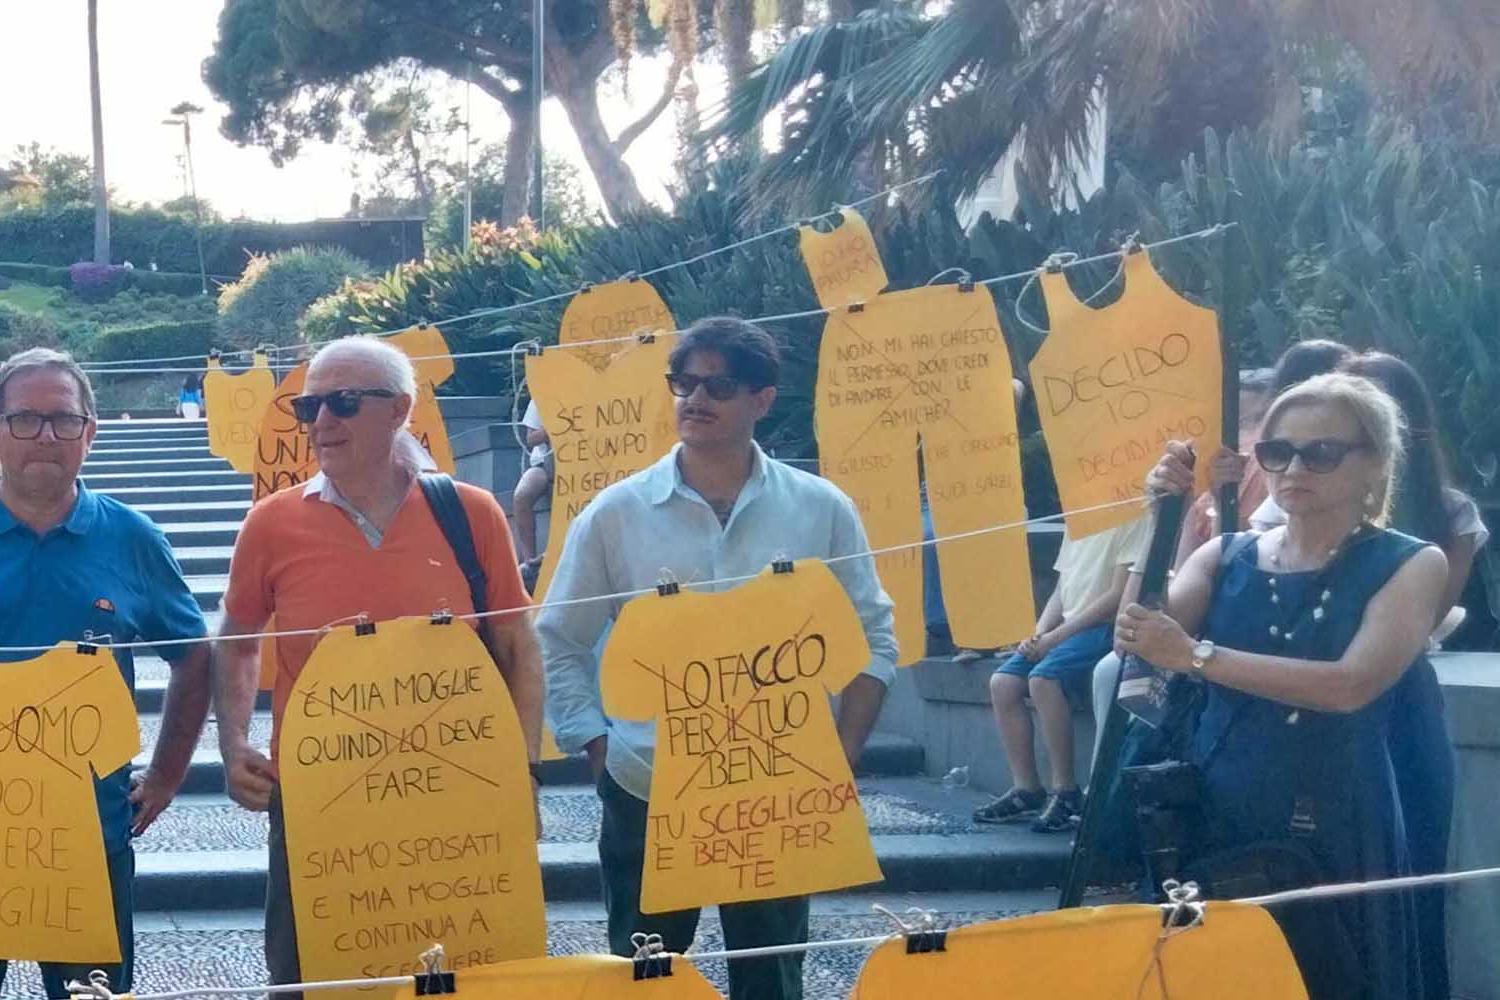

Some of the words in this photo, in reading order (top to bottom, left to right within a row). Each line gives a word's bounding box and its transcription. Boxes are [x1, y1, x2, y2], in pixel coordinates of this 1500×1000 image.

[884, 338, 902, 354] MI
[911, 333, 933, 350] HAI
[940, 327, 998, 348] CHIESTO
[1043, 333, 1191, 417] DECIDO
[550, 405, 586, 437] SE
[595, 397, 643, 428] NON
[1106, 390, 1150, 424] IO
[556, 474, 575, 497] DI
[329, 682, 386, 716] MIA
[394, 666, 483, 706] MOGLIE
[661, 661, 712, 715] LO
[297, 730, 389, 766] QUINDI
[398, 723, 428, 753] LO
[438, 714, 496, 747] DEVE
[666, 712, 719, 757] PER
[748, 690, 810, 736] TUO
[697, 732, 796, 790] BENE
[365, 766, 445, 803] FARE
[648, 812, 685, 841] TU
[796, 783, 862, 816] COSA
[302, 841, 391, 878] SIAMO
[397, 832, 500, 867] SPOSATI
[690, 831, 766, 867] BENE
[780, 821, 835, 853] PER
[350, 887, 396, 915] MIA
[408, 873, 513, 905] MOGLIE
[729, 859, 776, 890] TE
[333, 913, 458, 952] CONTINUA
[468, 909, 490, 934] A
